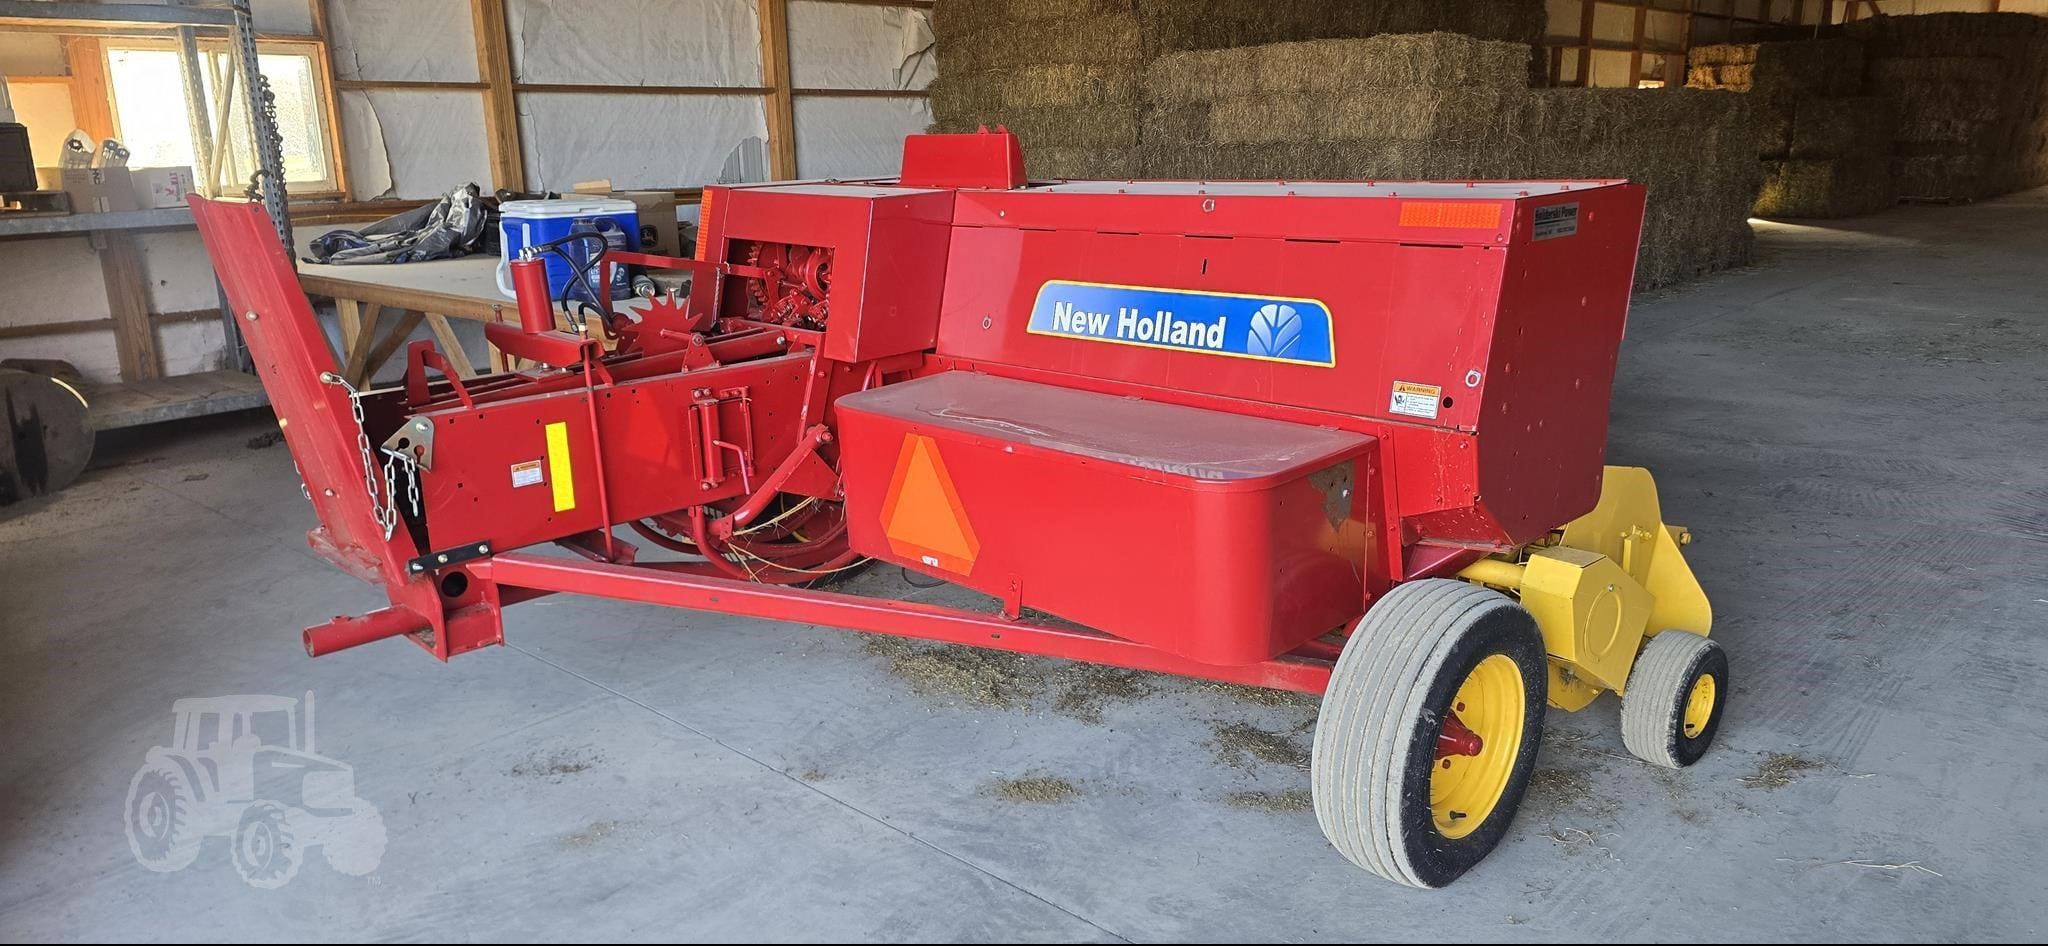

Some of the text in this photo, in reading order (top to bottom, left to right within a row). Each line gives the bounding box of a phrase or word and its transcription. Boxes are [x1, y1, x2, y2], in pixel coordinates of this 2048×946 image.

[1053, 301, 1227, 349] New Holland
[1406, 386, 1436, 395] WARNING
